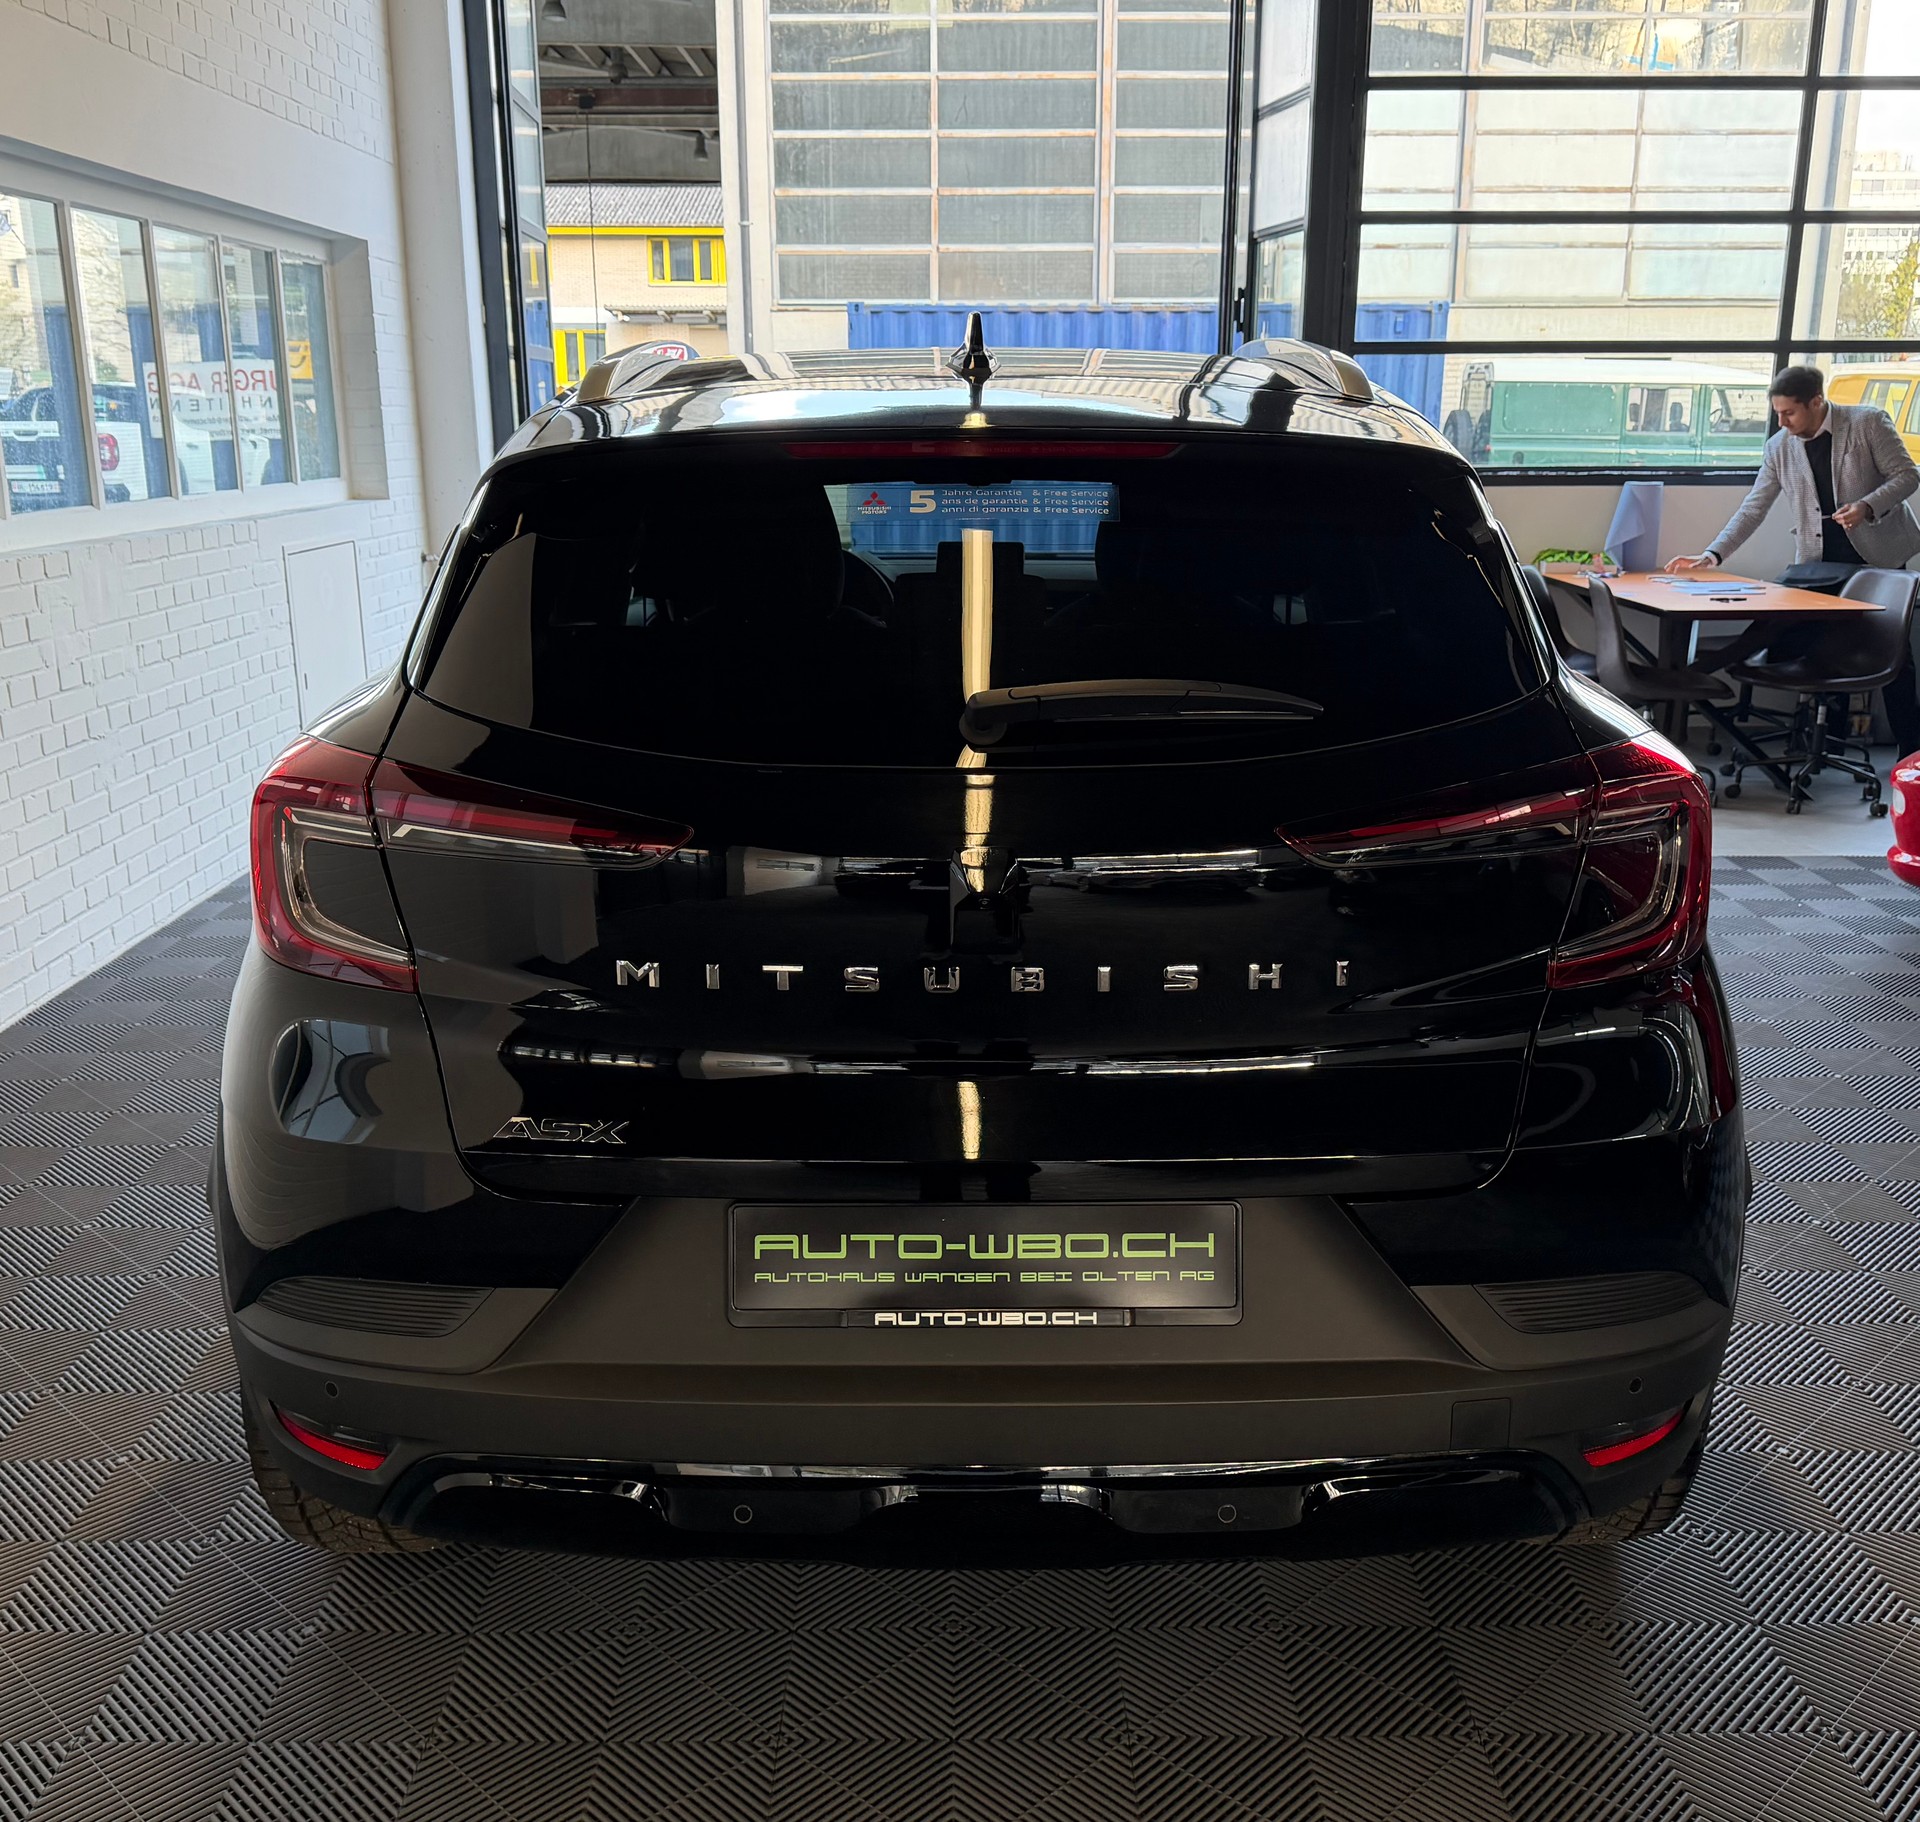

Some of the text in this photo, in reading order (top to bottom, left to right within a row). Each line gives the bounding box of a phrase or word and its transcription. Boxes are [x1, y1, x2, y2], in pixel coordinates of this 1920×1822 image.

[1044, 489, 1067, 497] Free
[1071, 489, 1109, 497] Service
[909, 489, 937, 514] 5
[964, 497, 978, 505] de
[981, 498, 1028, 506] garantie
[1071, 498, 1109, 506] Service
[981, 506, 1029, 514] garanzia
[615, 959, 1350, 993] MITSUBISHI
[493, 1116, 630, 1144] ASX
[754, 1232, 1215, 1260] AUTO-WBO.CH
[754, 1270, 1215, 1283] AUTOHAUS WANGEN BEI OLTEN AG
[874, 1311, 1098, 1326] AUTO-WBO.CH
